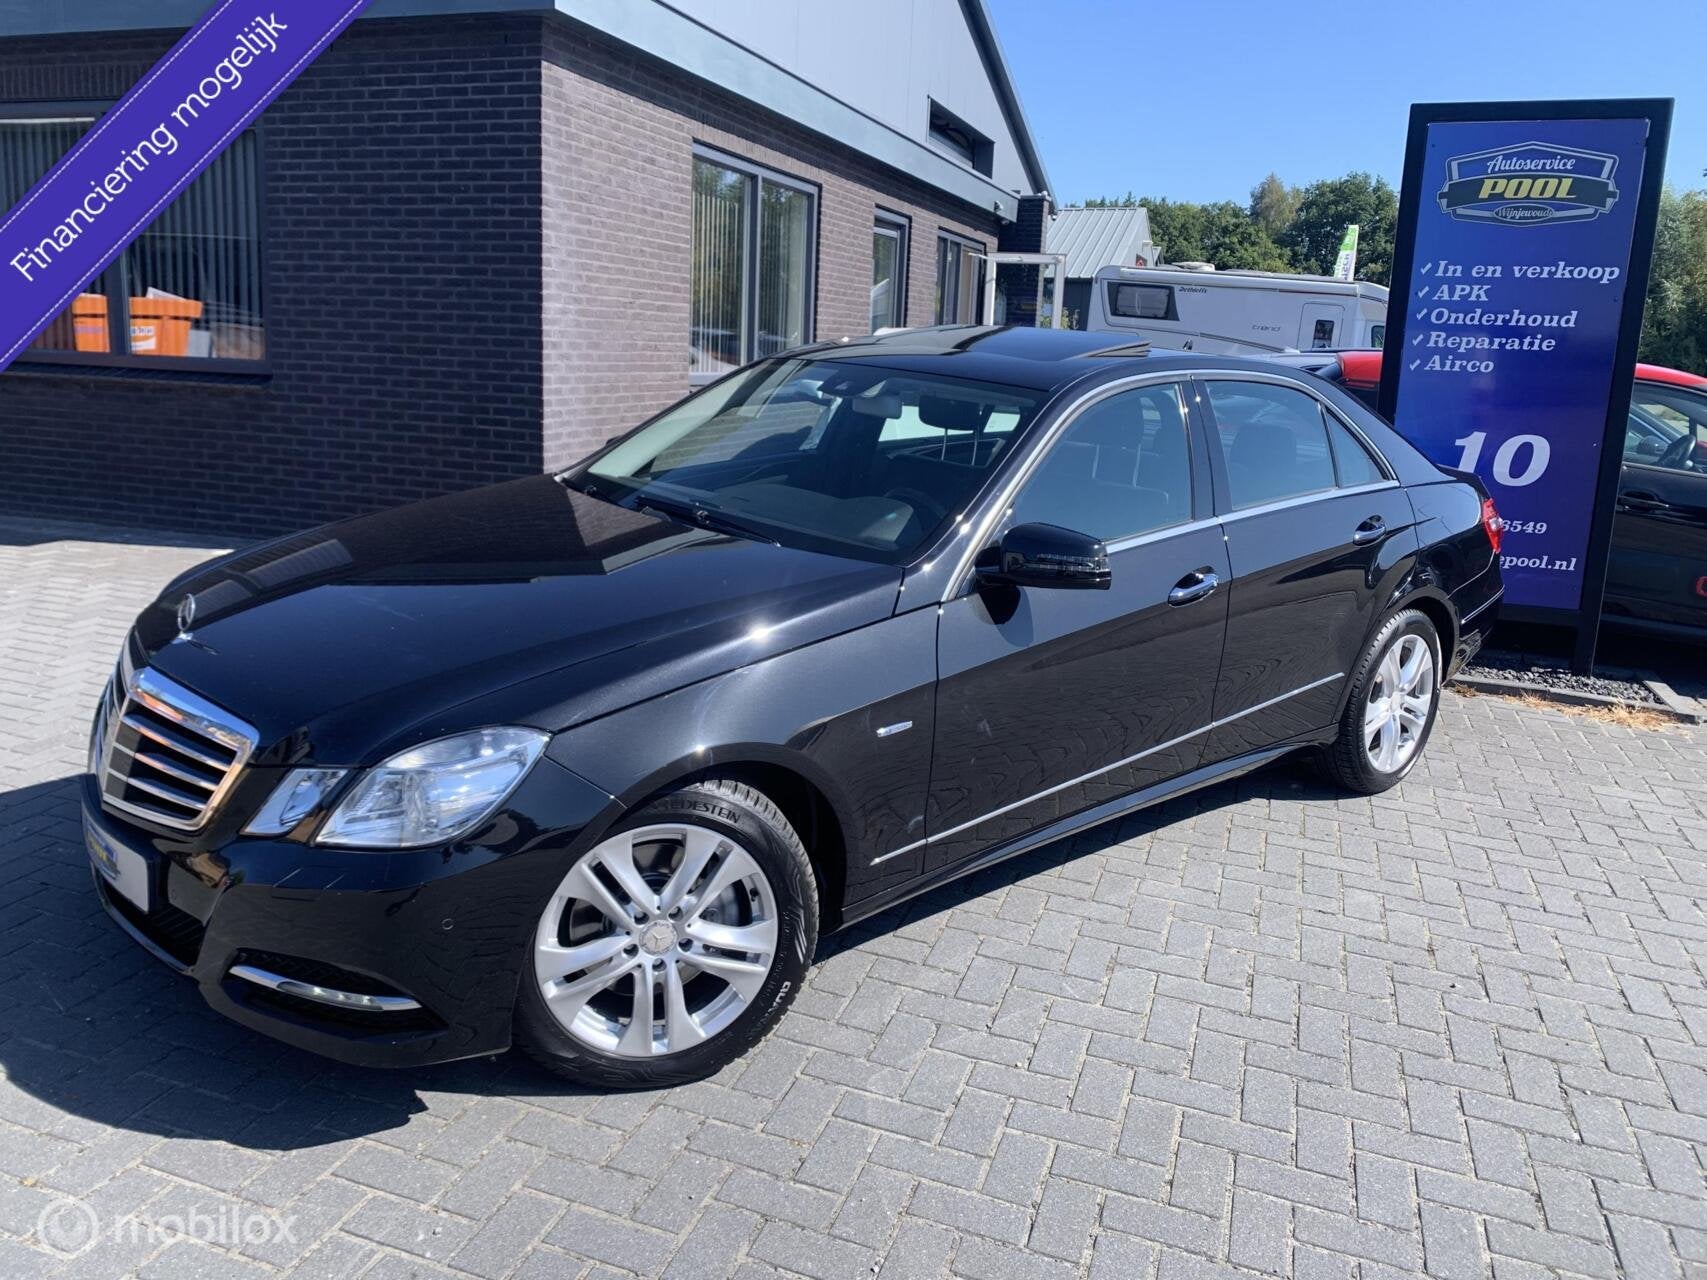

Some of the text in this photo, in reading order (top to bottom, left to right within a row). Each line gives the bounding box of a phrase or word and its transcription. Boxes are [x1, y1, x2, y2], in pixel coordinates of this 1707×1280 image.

[1487, 155, 1576, 174] Autoservice
[1478, 177, 1577, 199] POOL
[1434, 260, 1620, 284] In en verkoop
[1432, 284, 1491, 301] APK
[1430, 307, 1578, 328] Onderhoud
[1426, 331, 1556, 352] Reparatie
[1424, 355, 1494, 373] Airco
[1454, 431, 1551, 487] 10
